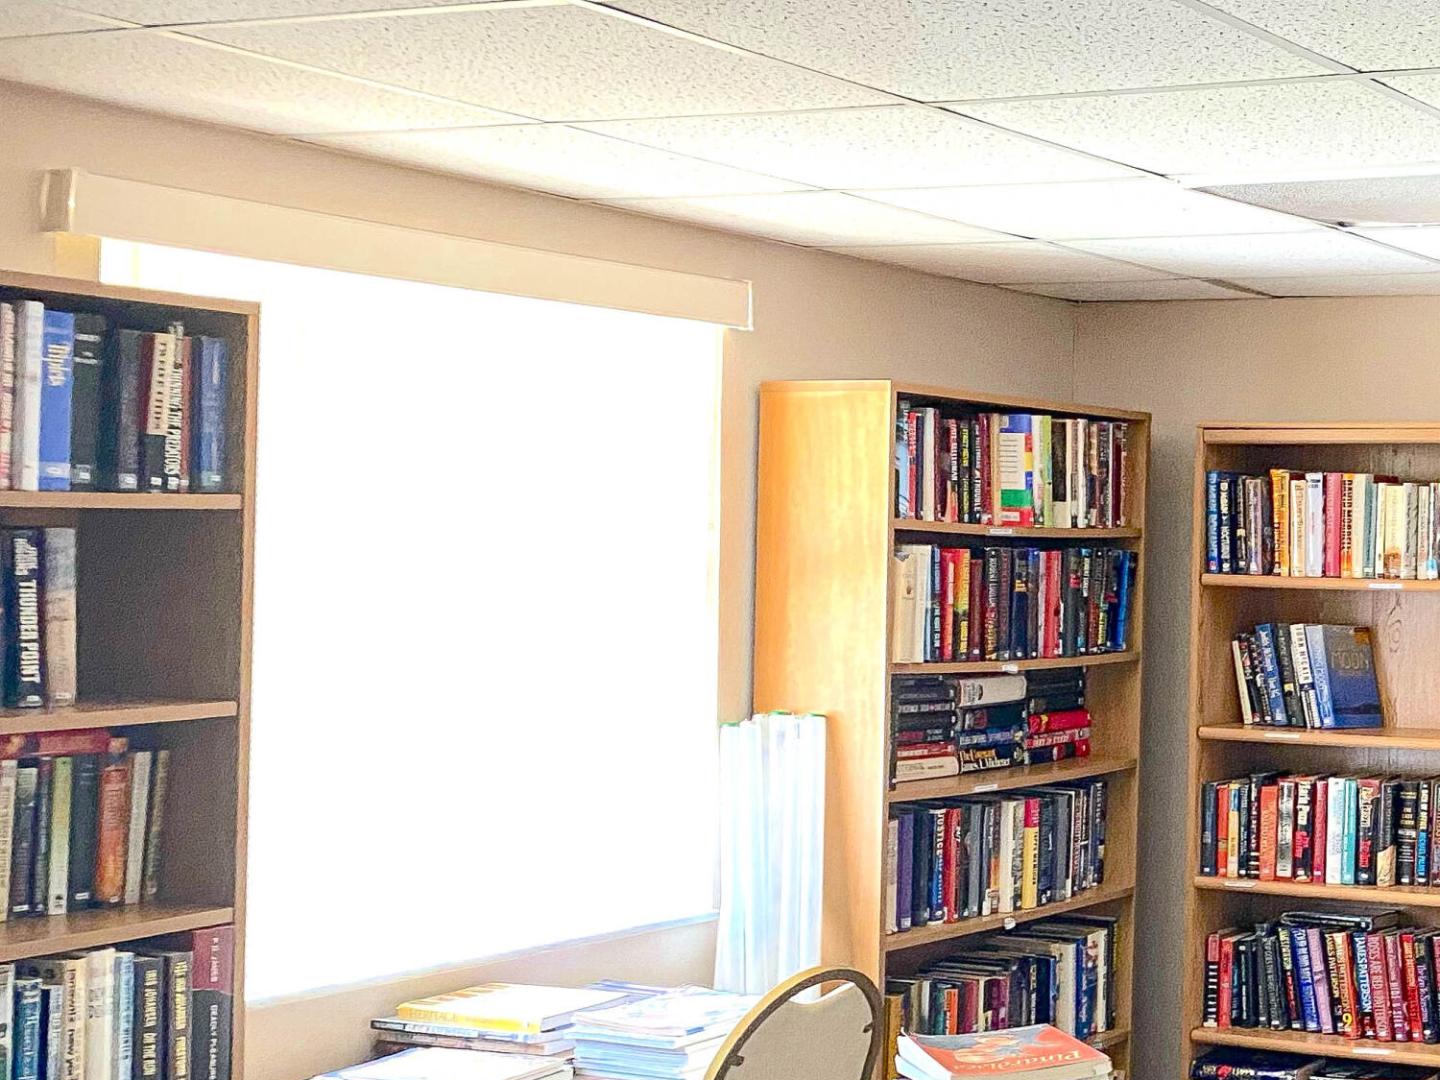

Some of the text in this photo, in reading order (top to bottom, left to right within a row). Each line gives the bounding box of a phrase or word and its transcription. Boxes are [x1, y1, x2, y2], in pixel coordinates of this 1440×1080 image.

[20, 642, 41, 684] POINT
[1353, 936, 1372, 1013] JAMES PATTERSON
